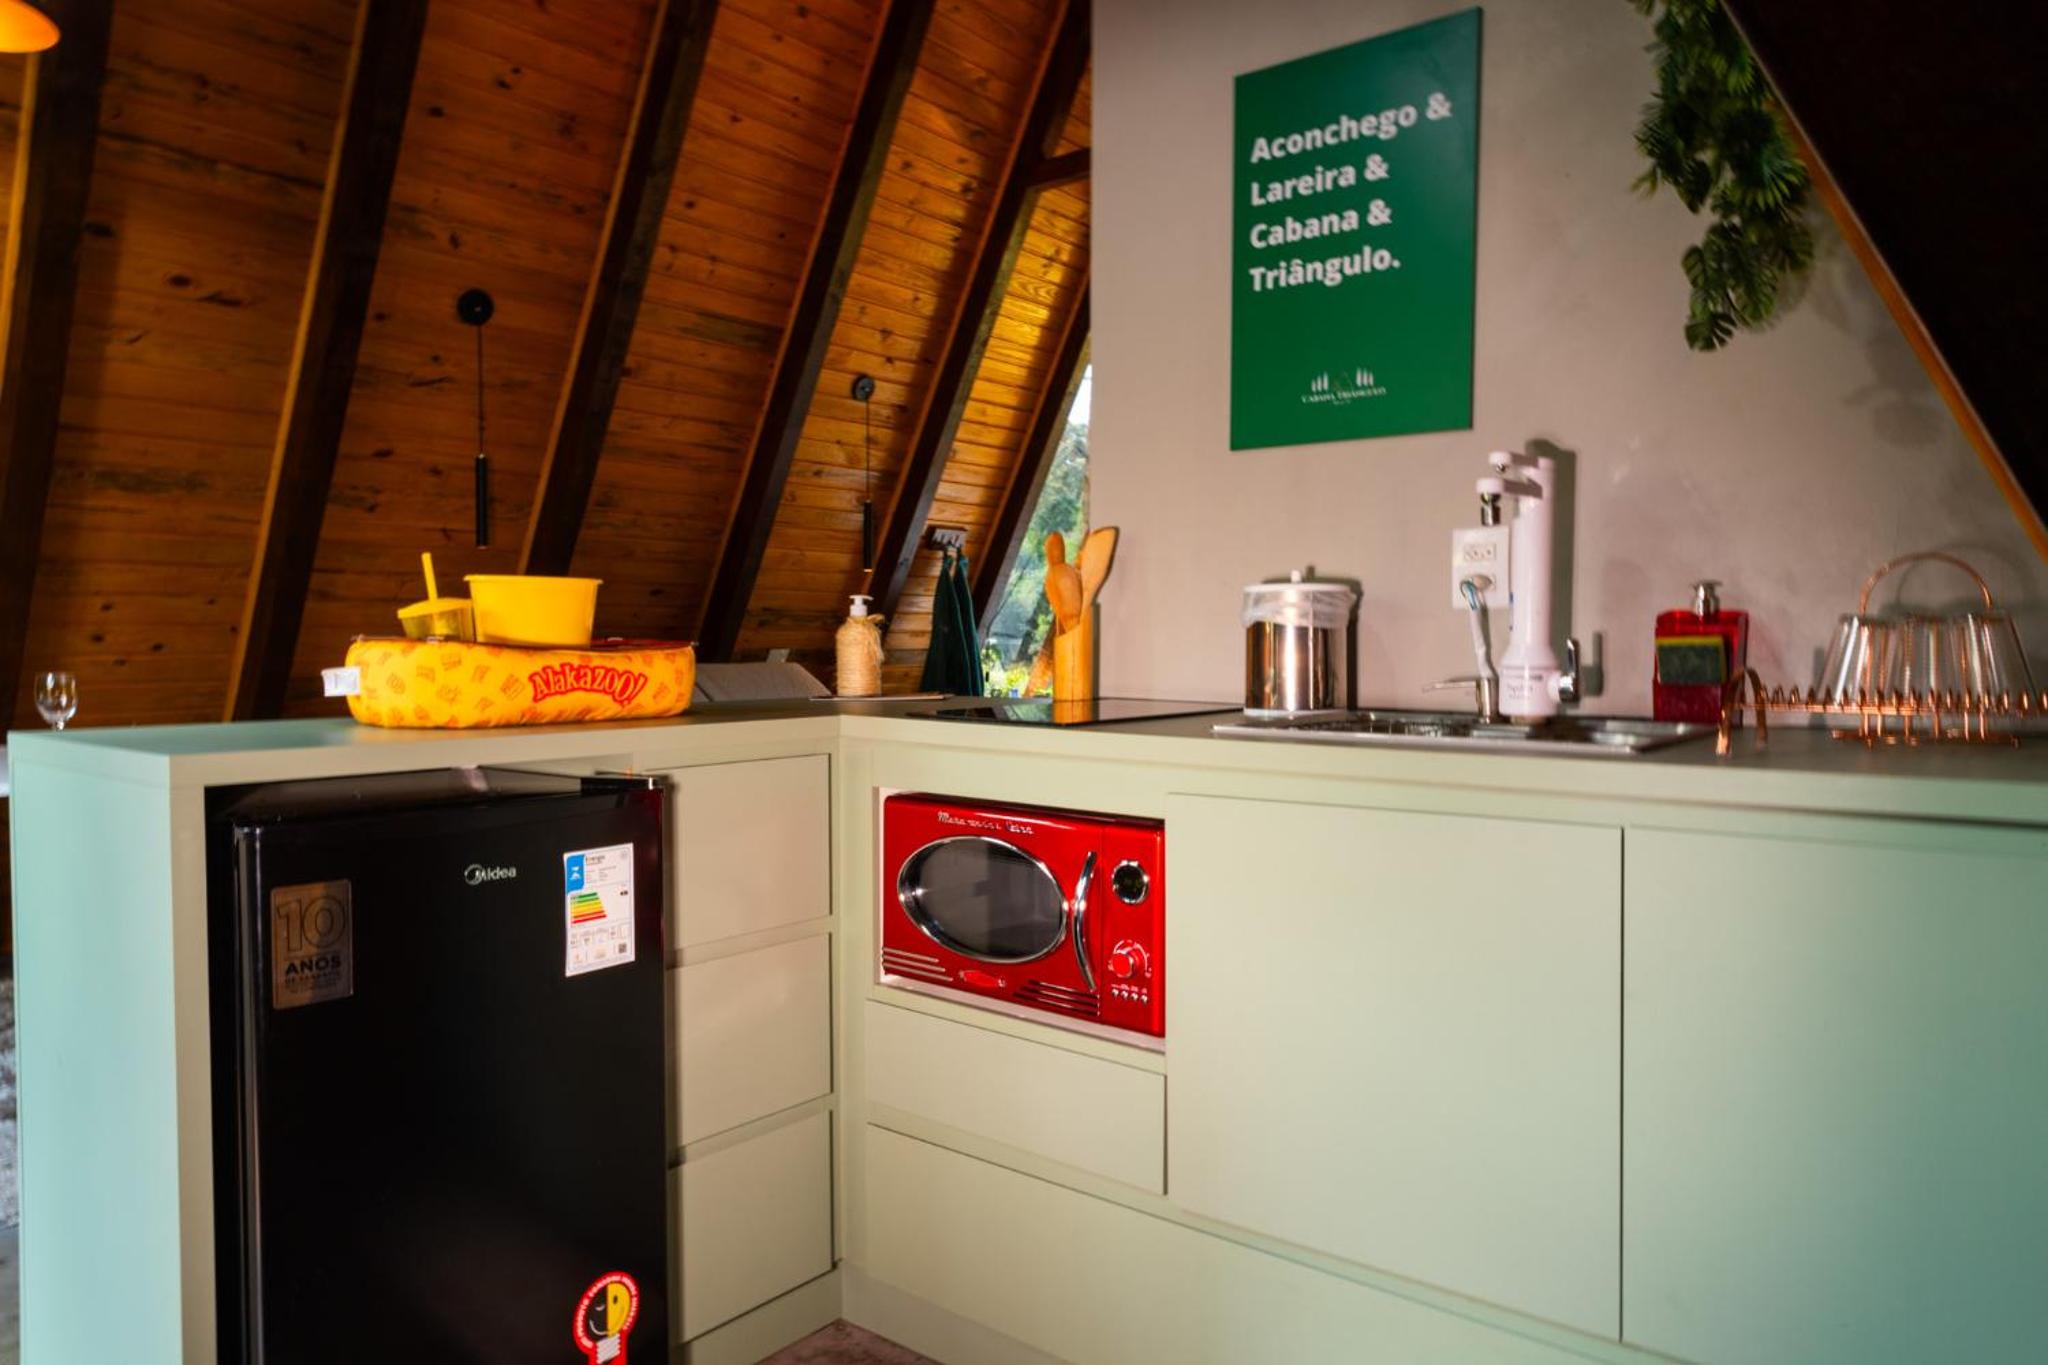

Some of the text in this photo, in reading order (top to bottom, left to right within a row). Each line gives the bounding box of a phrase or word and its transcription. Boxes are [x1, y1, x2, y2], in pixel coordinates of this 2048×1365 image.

[1250, 92, 1452, 163] Aconchego &
[1250, 153, 1389, 207] Lareira &
[1249, 199, 1392, 249] Cabana &
[1248, 244, 1402, 292] Triângulo.
[464, 864, 517, 885] Midea
[277, 896, 345, 952] 10
[285, 955, 341, 976] ANOS
